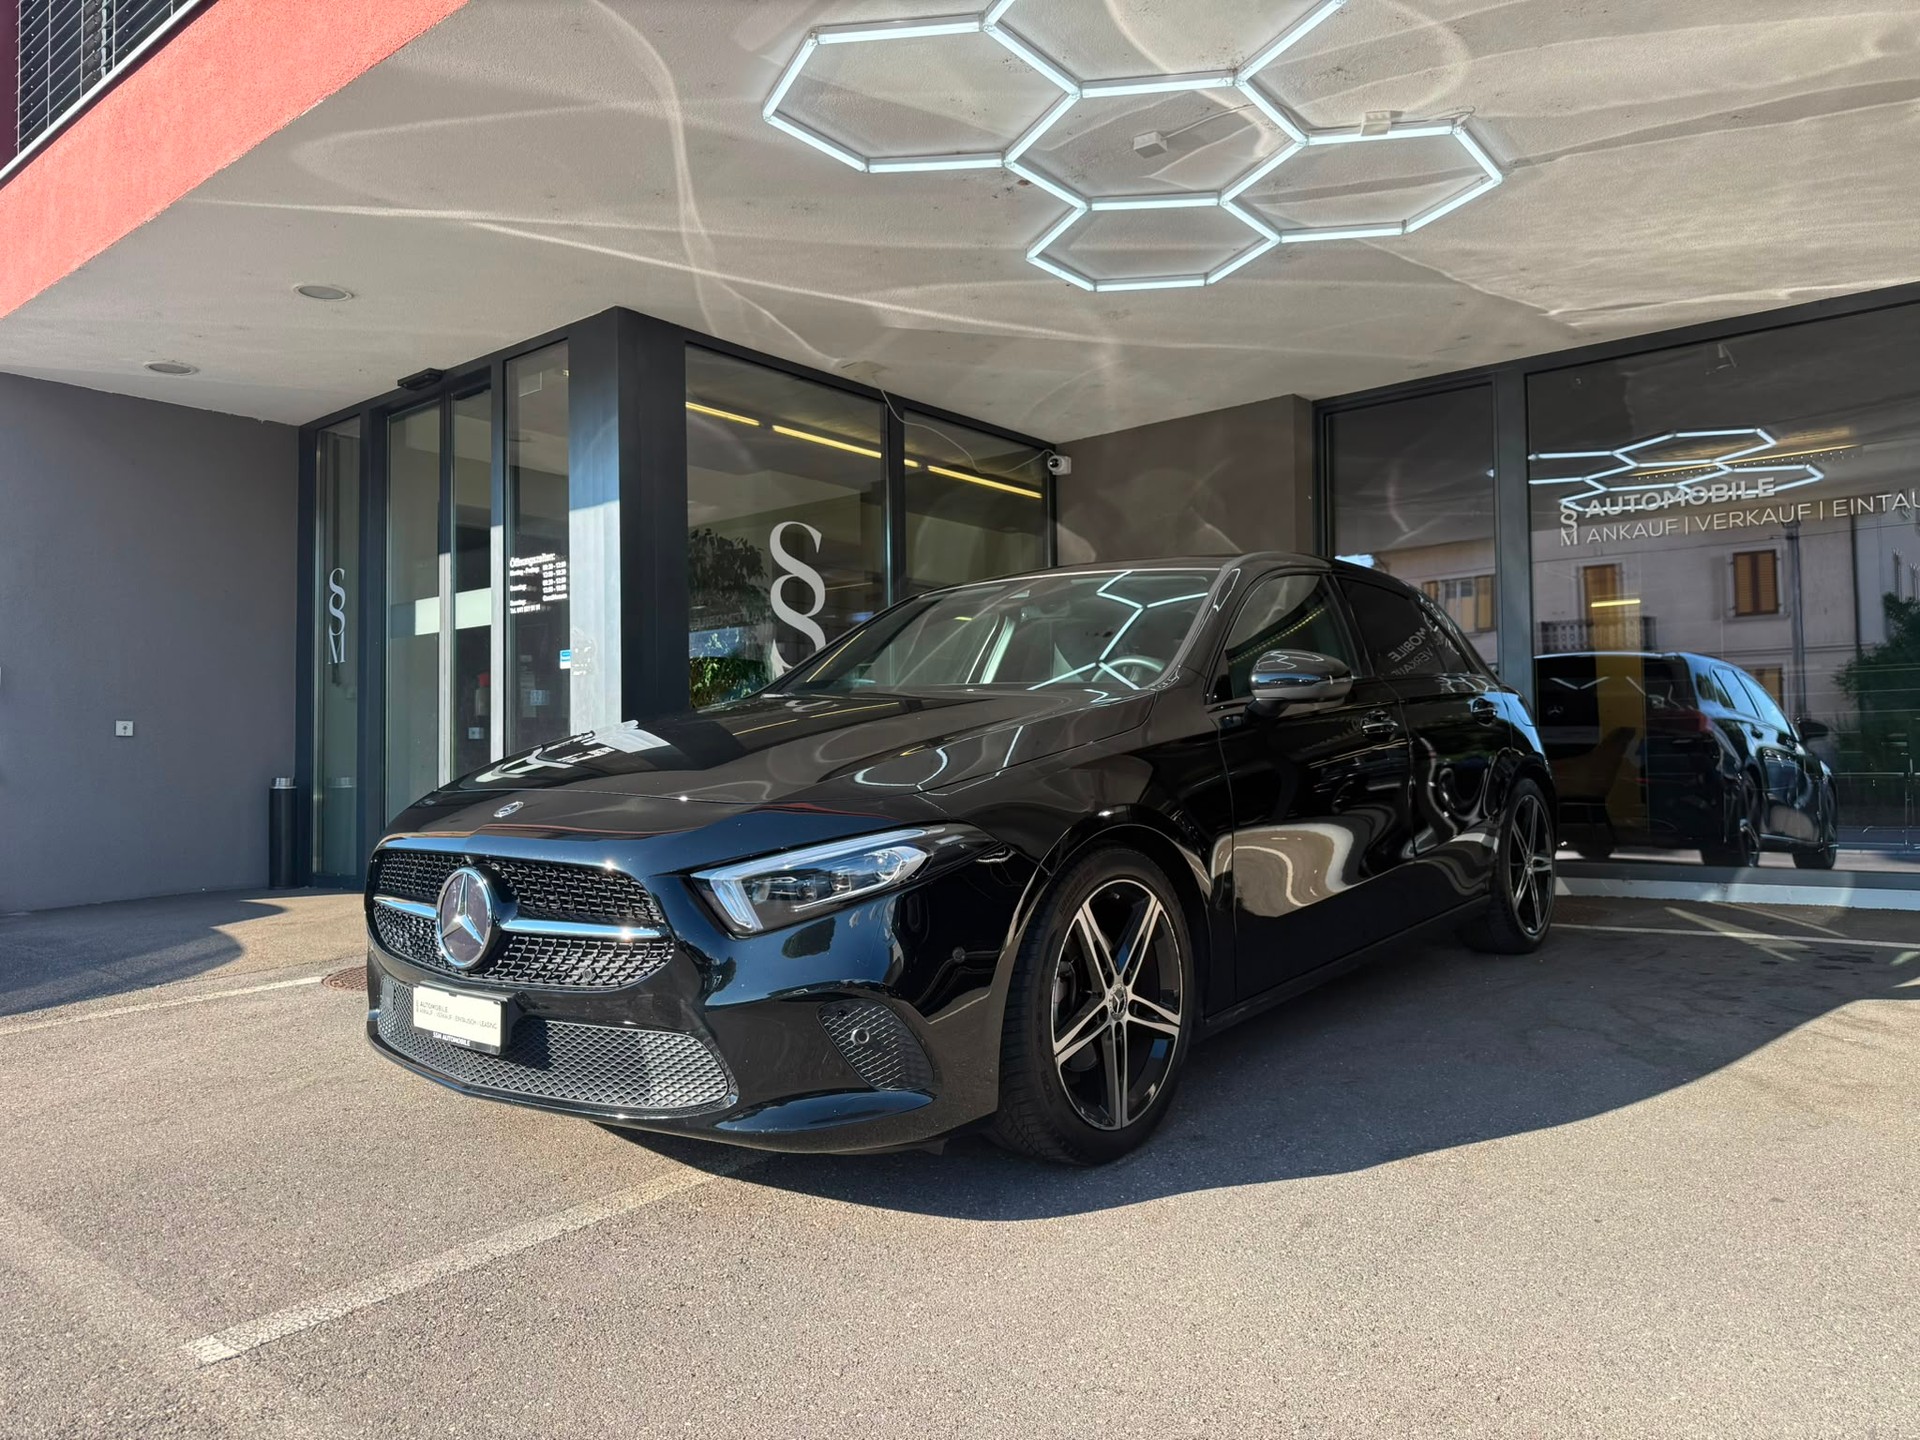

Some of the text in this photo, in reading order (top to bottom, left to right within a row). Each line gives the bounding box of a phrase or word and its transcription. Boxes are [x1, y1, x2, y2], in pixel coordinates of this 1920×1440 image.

[1585, 477, 1776, 519] AUTOMOBILE
[1586, 518, 1681, 544] ANKAUF
[1696, 503, 1812, 532] VERKAUF
